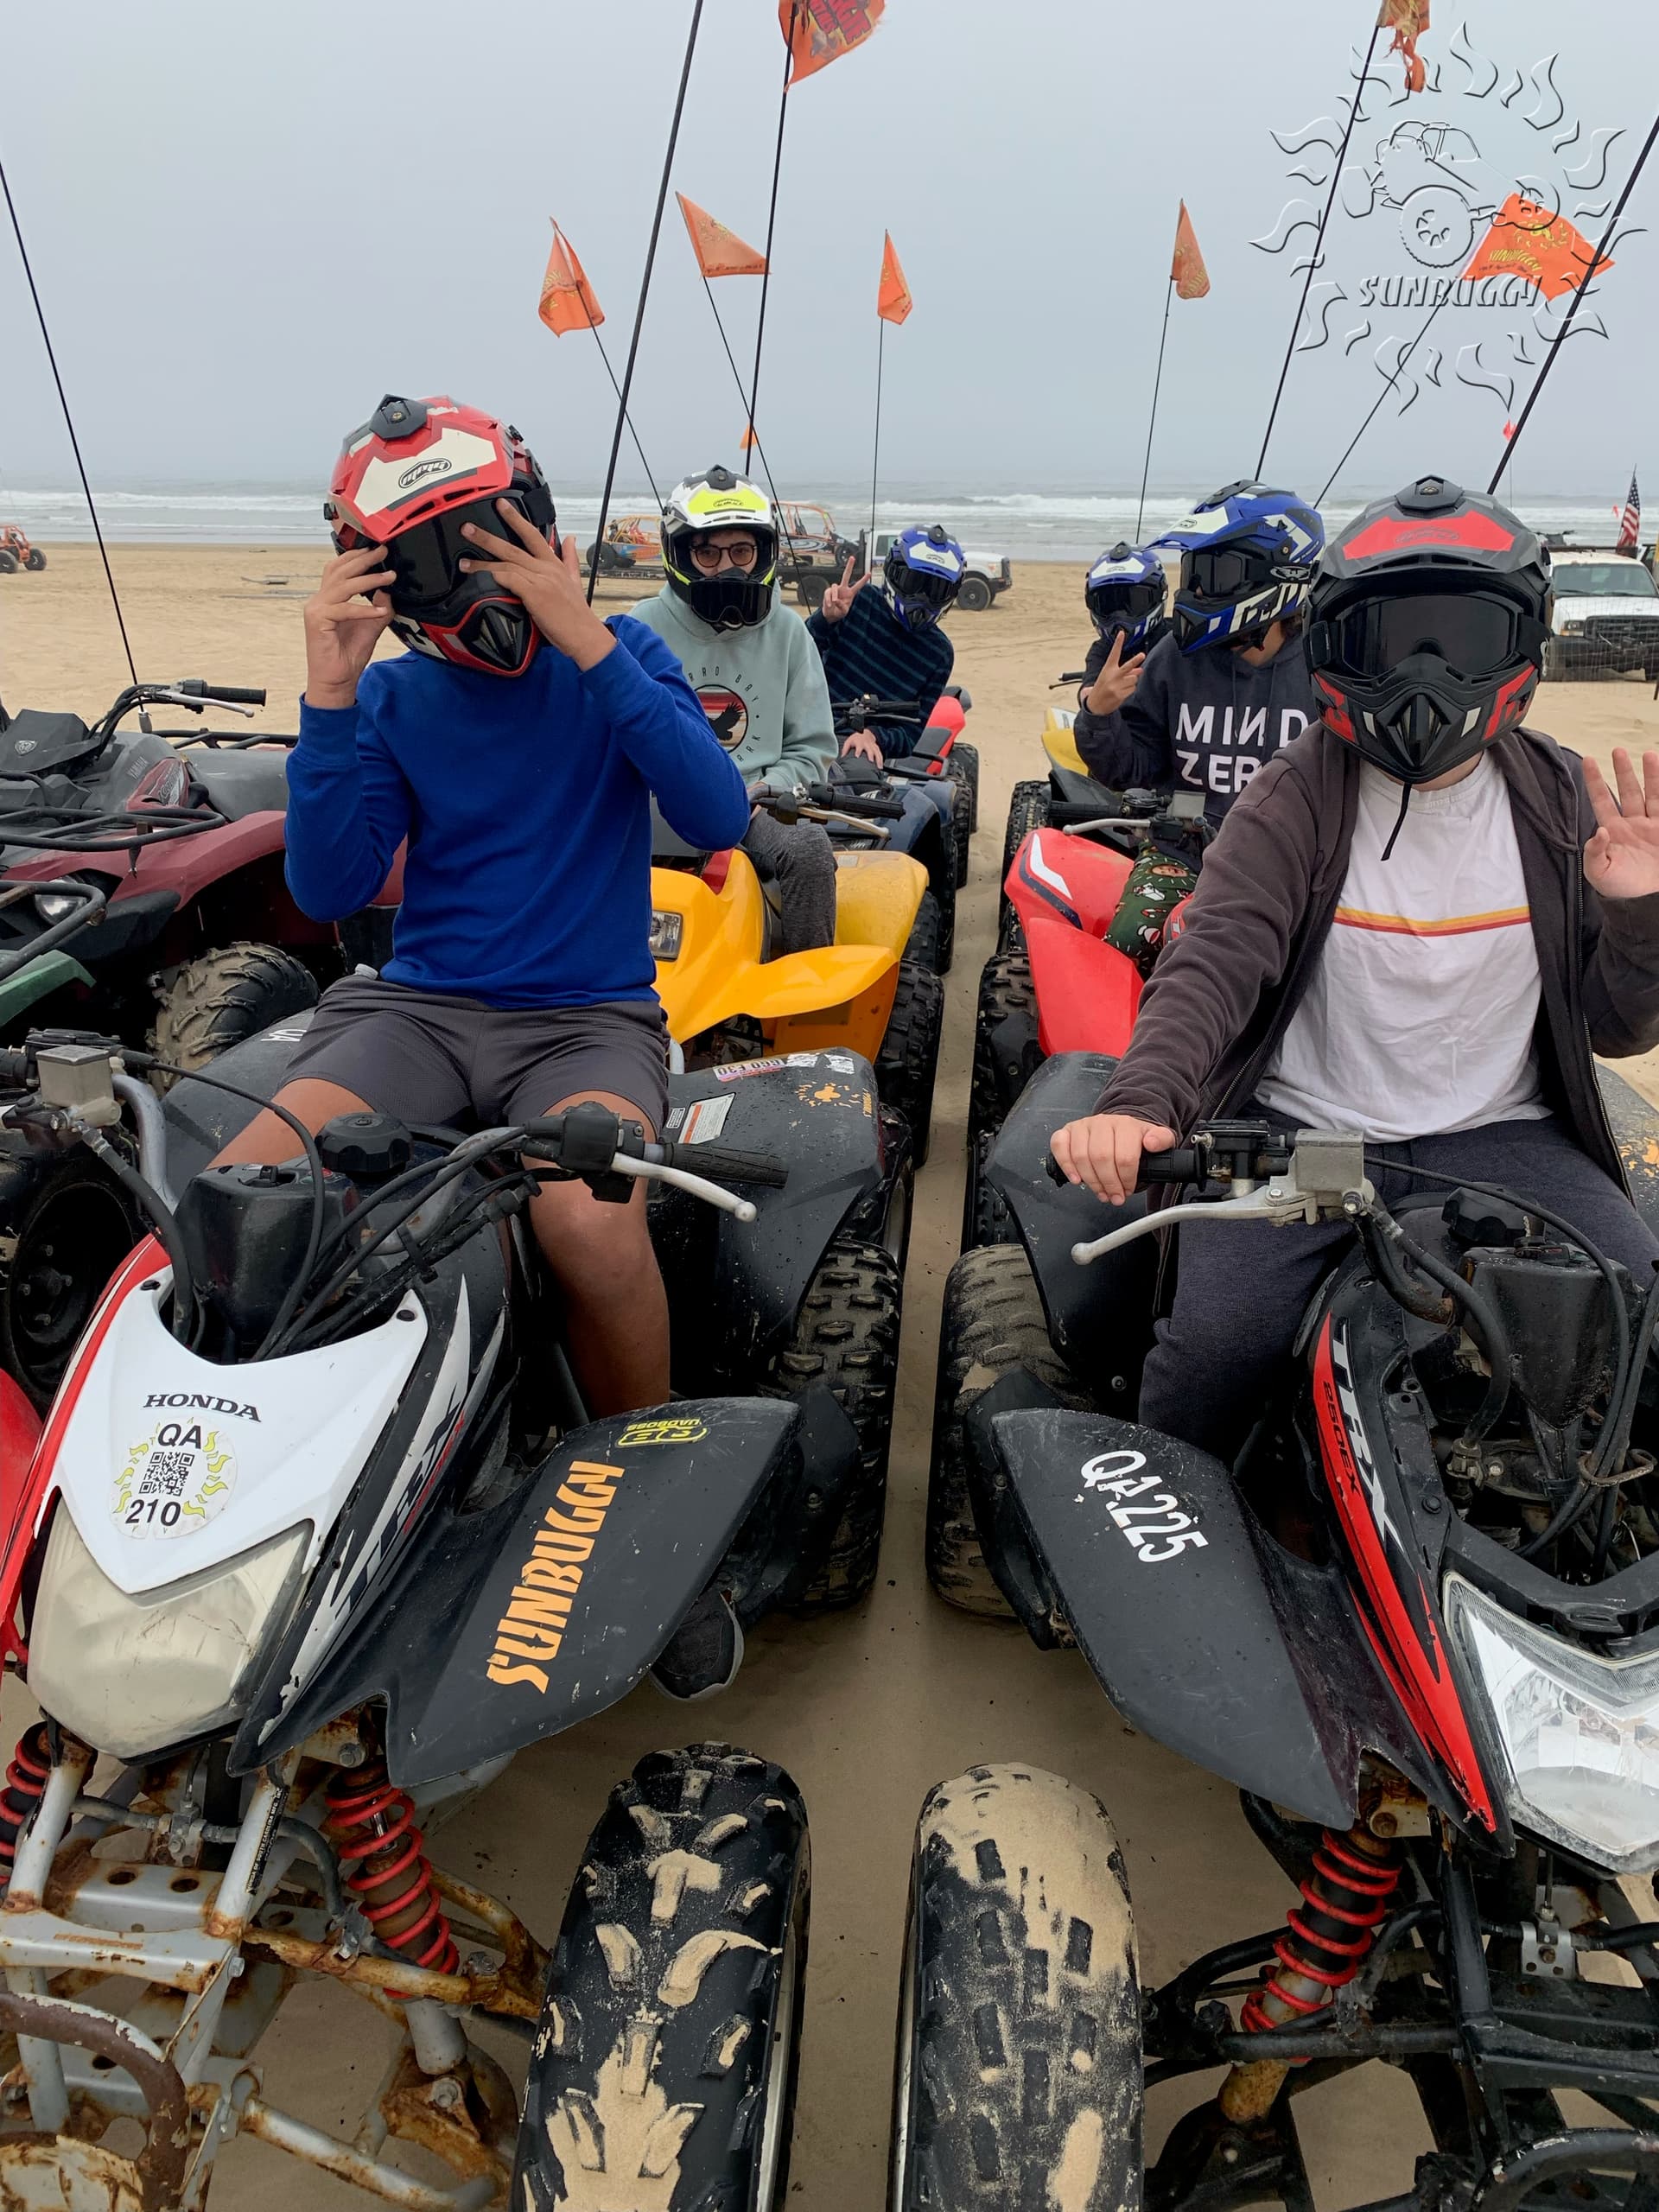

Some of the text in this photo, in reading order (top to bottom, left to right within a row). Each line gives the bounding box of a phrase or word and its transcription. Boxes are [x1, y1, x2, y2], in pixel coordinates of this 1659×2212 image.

[143, 1394, 262, 1422] HONDA
[157, 1423, 201, 1450] QA
[1323, 1381, 1361, 1497] 250EX
[1332, 1323, 1405, 1554] TRX
[125, 1498, 181, 1527] 210
[486, 1459, 626, 1694] SUNBUGGY
